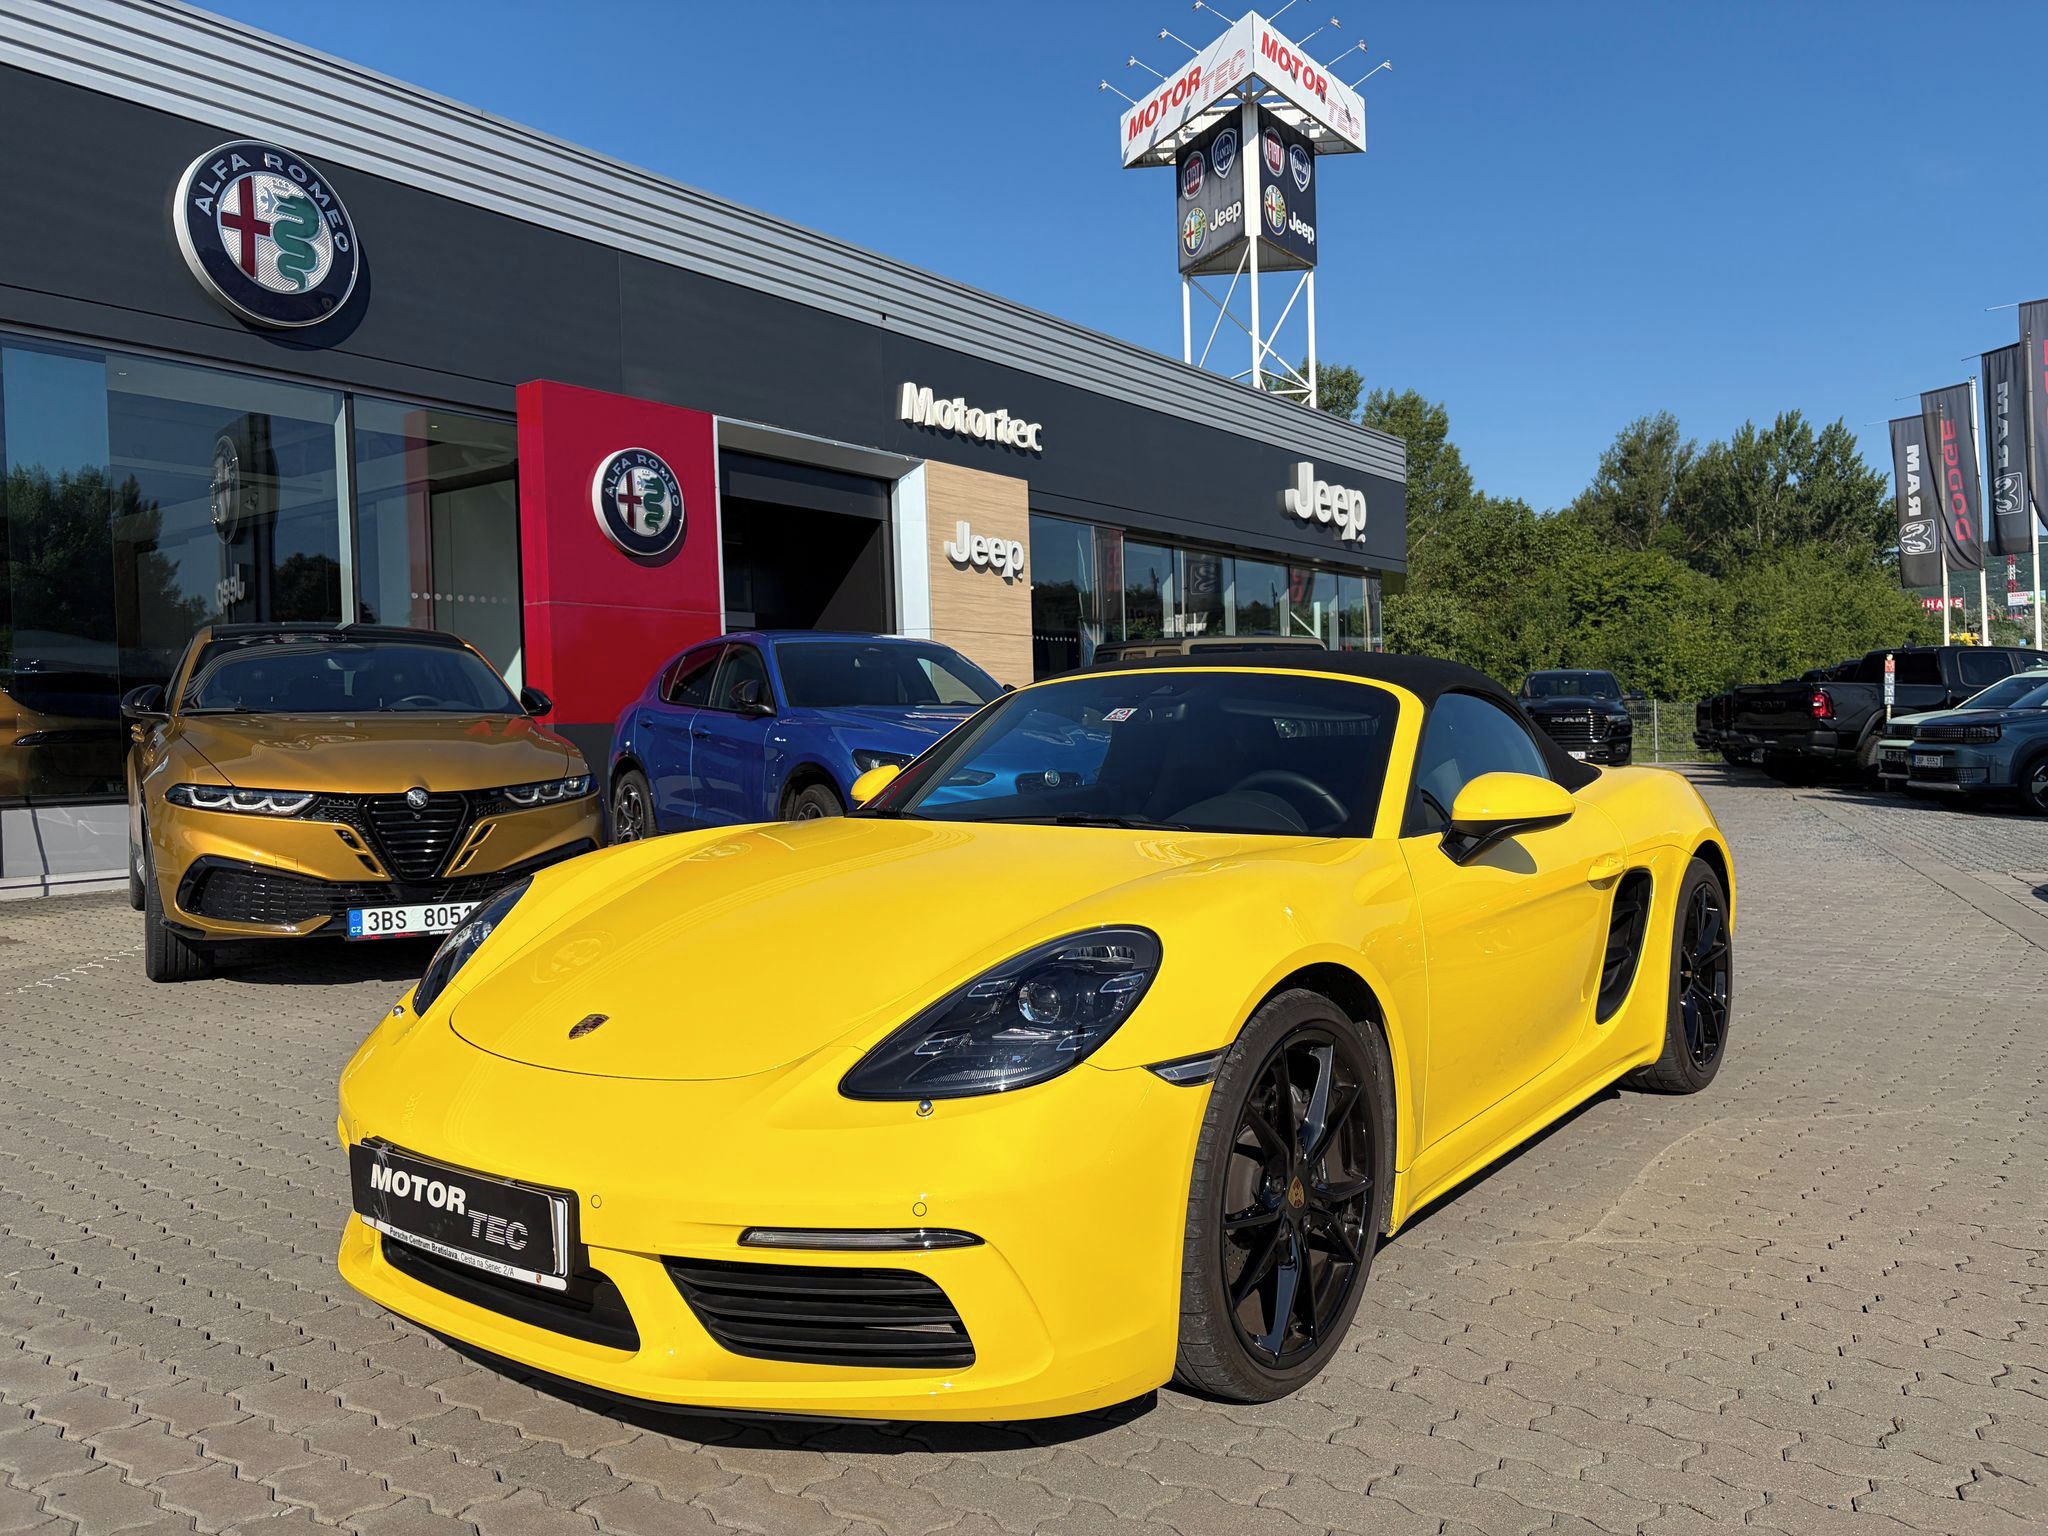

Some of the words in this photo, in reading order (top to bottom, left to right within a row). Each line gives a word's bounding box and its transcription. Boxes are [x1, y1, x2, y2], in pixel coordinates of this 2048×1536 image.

[1127, 66, 1202, 141] MOTOR
[1200, 48, 1246, 101] TEC
[1261, 32, 1328, 103] MOTOR
[1327, 99, 1361, 140] TEC
[1186, 162, 1200, 190] FIAT
[195, 153, 251, 217] ALFA
[264, 152, 350, 253] ROMEO
[1209, 201, 1242, 231] Jeep
[1288, 211, 1315, 244] Jeep
[901, 382, 1043, 452] Motortec
[605, 457, 631, 498] ALFA
[636, 454, 680, 507] ROMEO
[1285, 462, 1367, 543] Jeep
[943, 520, 1025, 579] Jeep
[351, 926, 362, 934] CZ
[368, 910, 407, 932] 3BS
[370, 1163, 467, 1215] MOTOR
[389, 1226, 409, 1242] Porsche
[408, 1234, 431, 1250] Centrum
[460, 1252, 476, 1265] Cesta
[476, 1259, 484, 1268] na
[503, 1265, 515, 1277] 2/A
[467, 1208, 529, 1250] TEC
